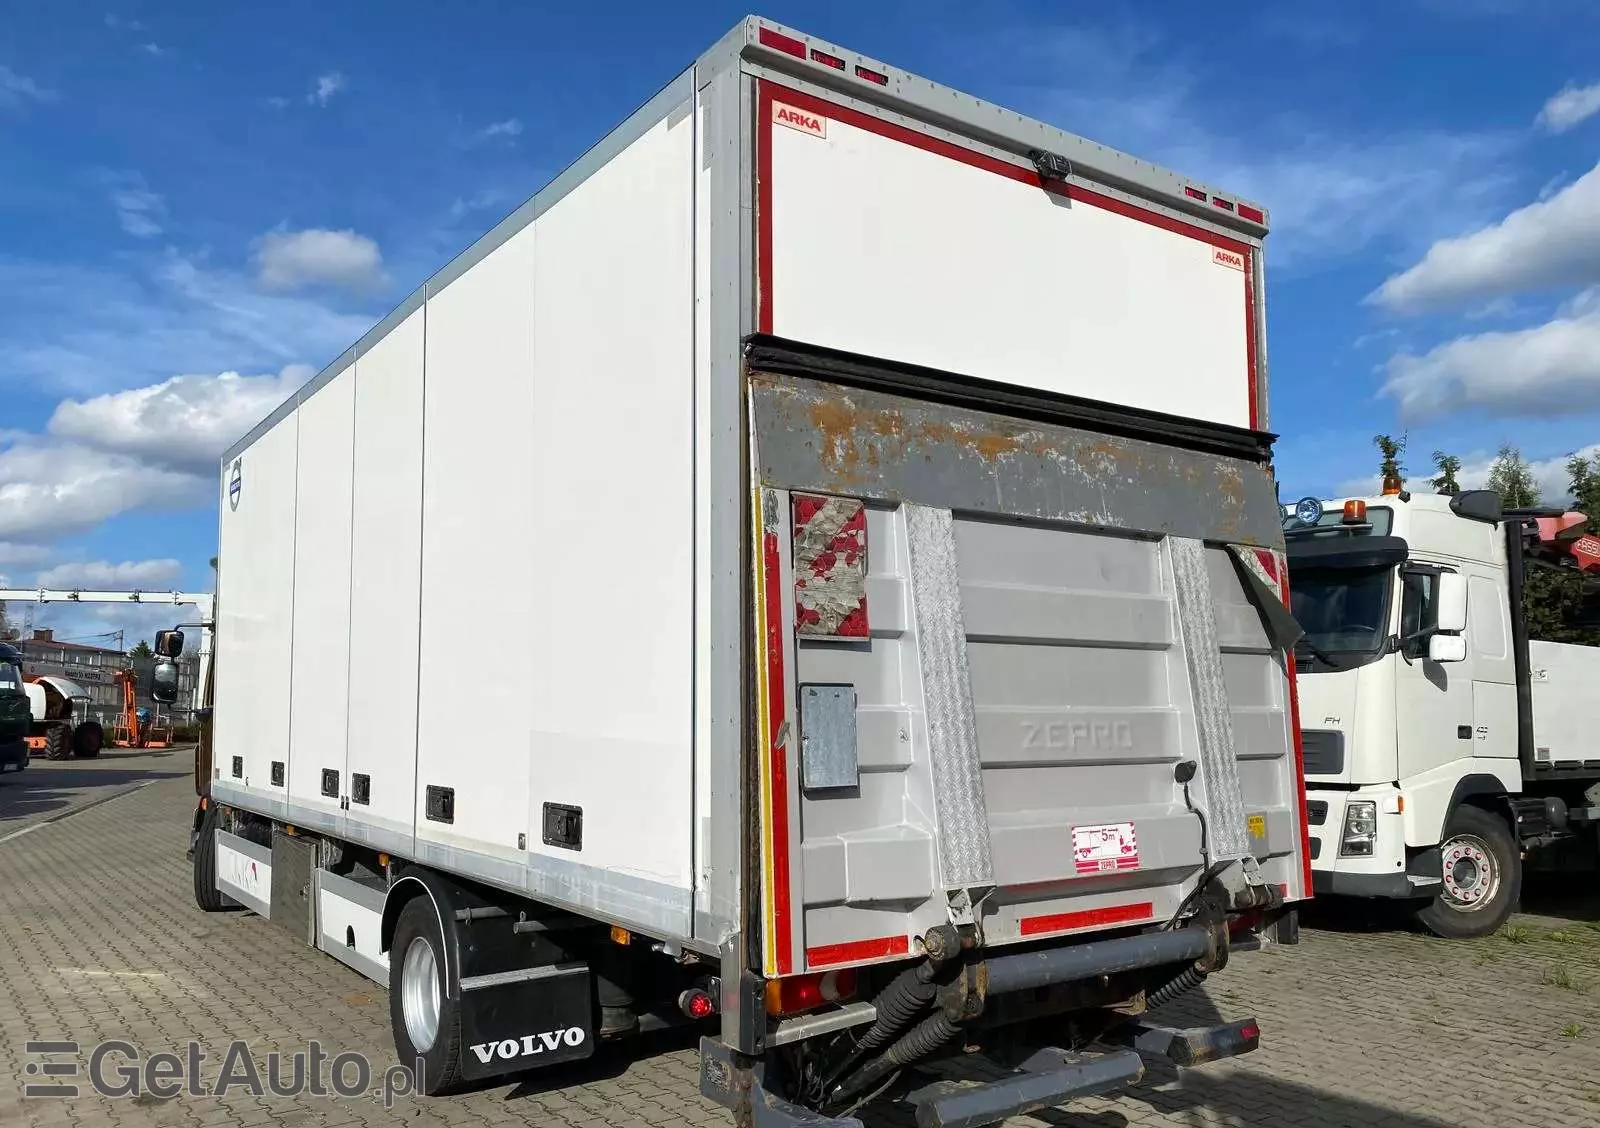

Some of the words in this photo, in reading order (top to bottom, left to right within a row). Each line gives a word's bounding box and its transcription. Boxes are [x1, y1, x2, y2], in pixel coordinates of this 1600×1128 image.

[777, 108, 821, 132] ARKA
[1215, 251, 1242, 266] ARKA
[1324, 717, 1341, 725] FH
[1020, 720, 1133, 750] ZEPRO
[469, 1026, 585, 1064] VOLVO
